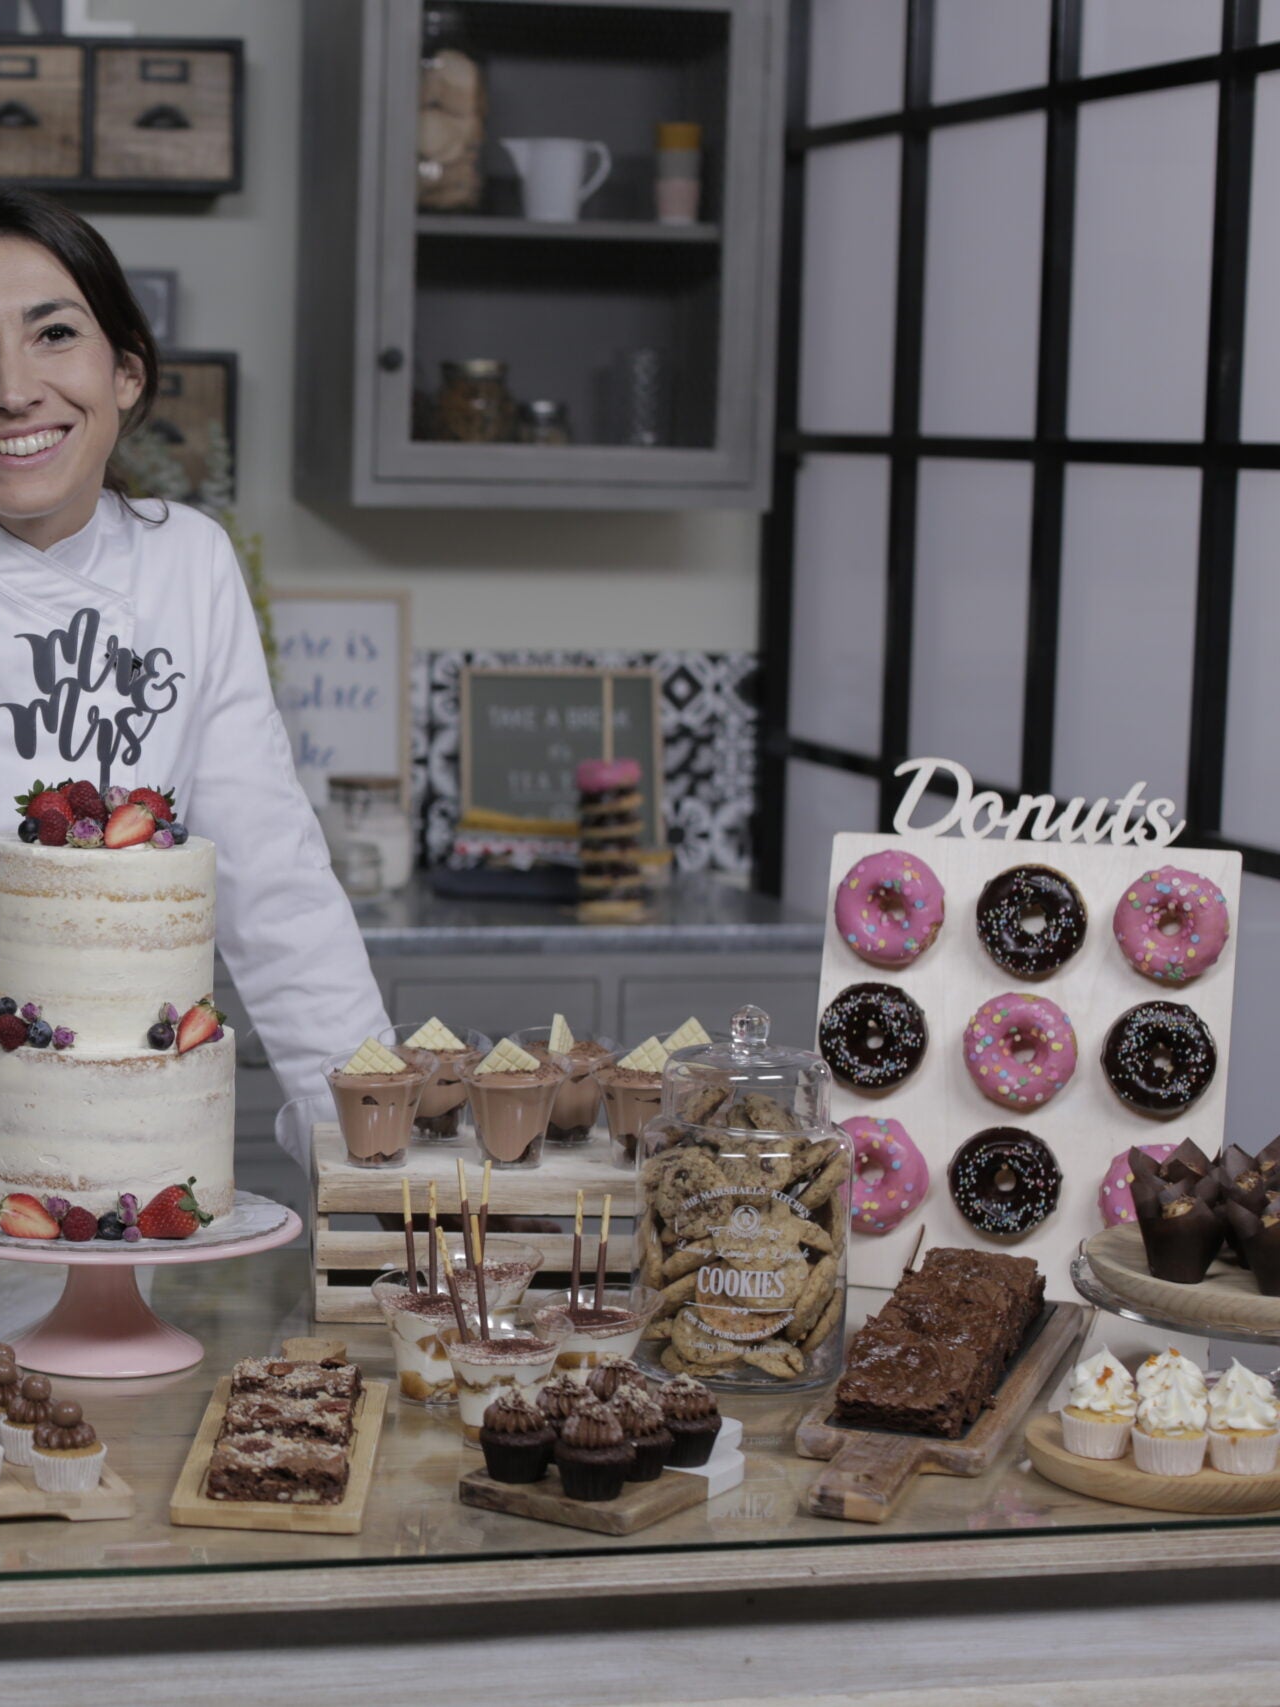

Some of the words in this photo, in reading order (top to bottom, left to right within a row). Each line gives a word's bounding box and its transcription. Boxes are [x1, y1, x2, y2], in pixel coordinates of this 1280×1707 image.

[14, 608, 133, 696] Mr
[130, 647, 186, 714] &
[893, 757, 1187, 848] Donuts
[681, 1197, 701, 1211] THE
[771, 1190, 812, 1220] KITCHEN
[697, 1266, 785, 1298] COOKIES
[683, 1310, 697, 1326] FOR
[696, 1320, 714, 1335] THE
[771, 1313, 796, 1331] LIVING
